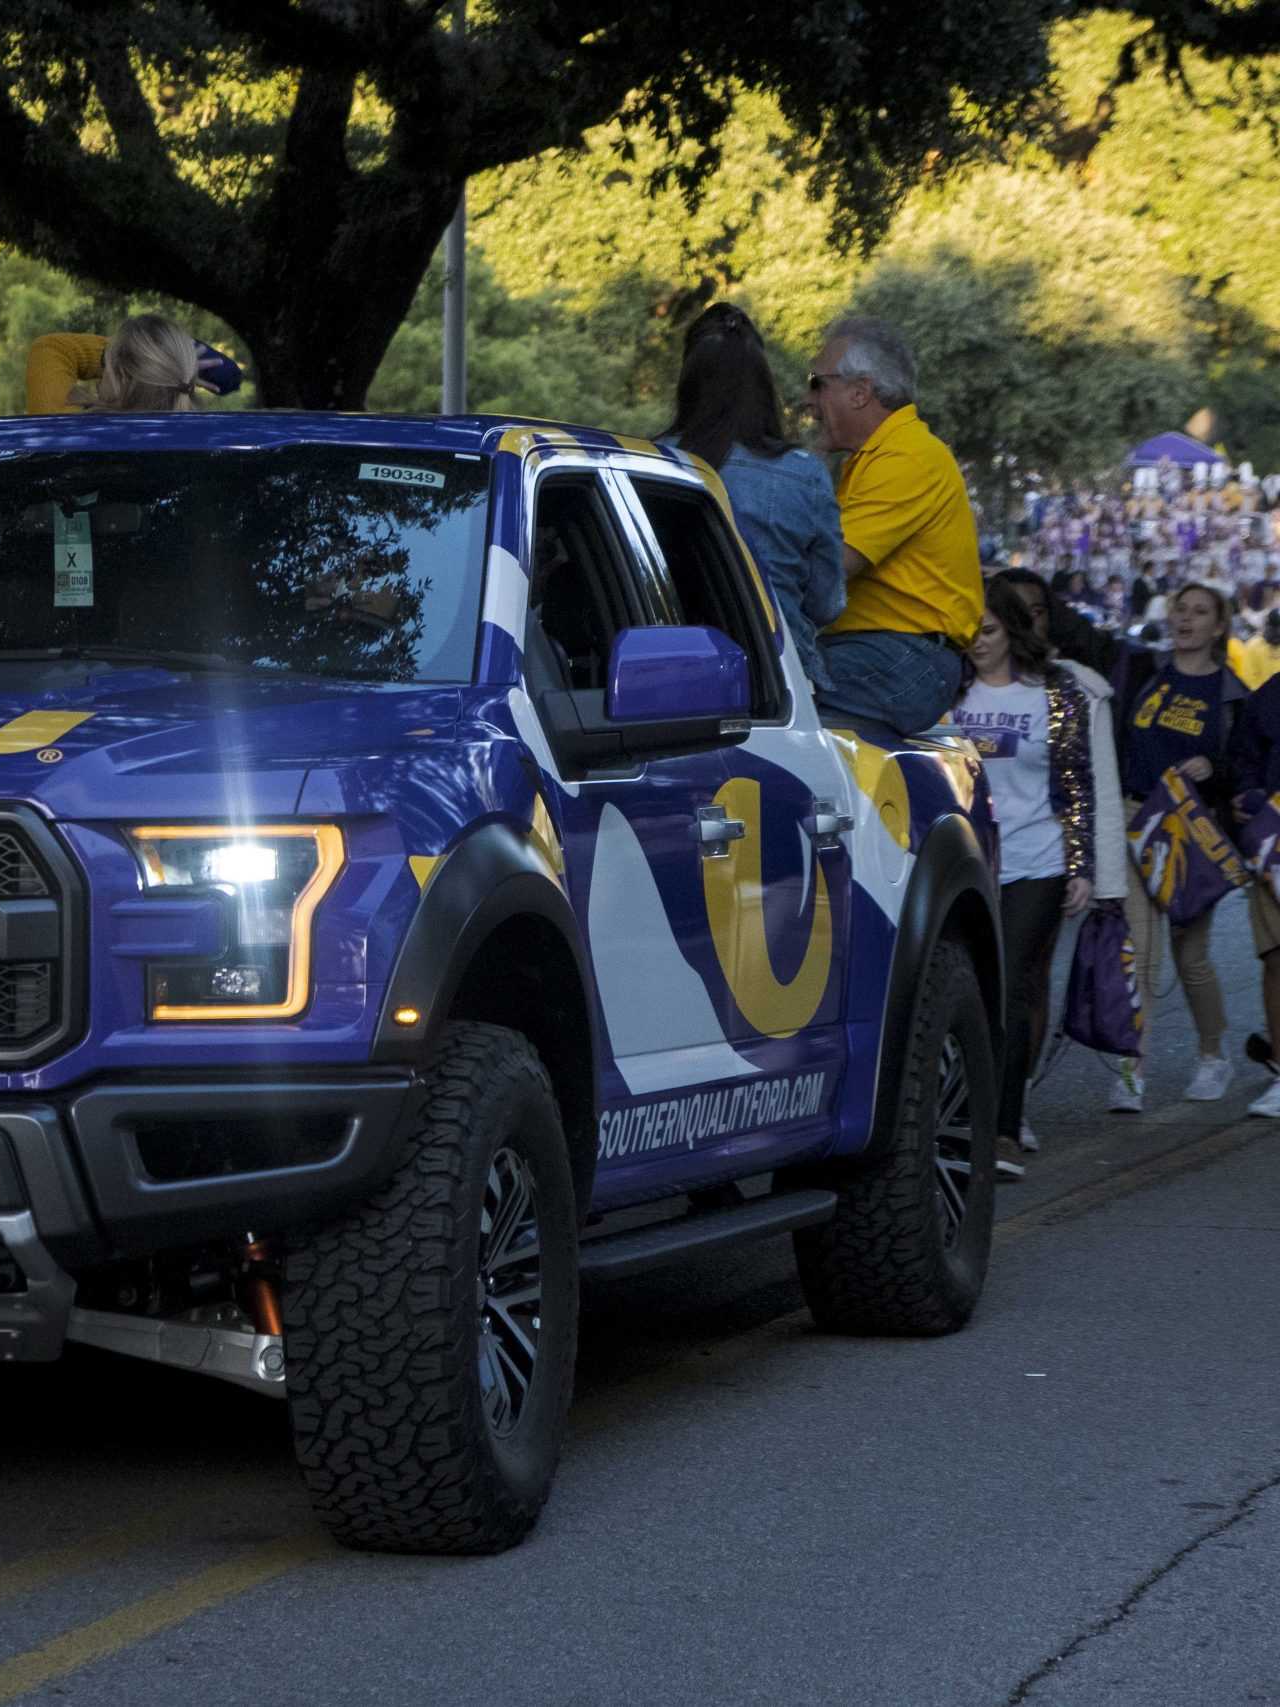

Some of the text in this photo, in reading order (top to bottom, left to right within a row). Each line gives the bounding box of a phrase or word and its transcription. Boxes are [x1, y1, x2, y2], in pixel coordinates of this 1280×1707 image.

[370, 466, 436, 484] 190349
[66, 551, 78, 569] X
[596, 1071, 826, 1161] SOUTHERNQUALITYFORD.COM
